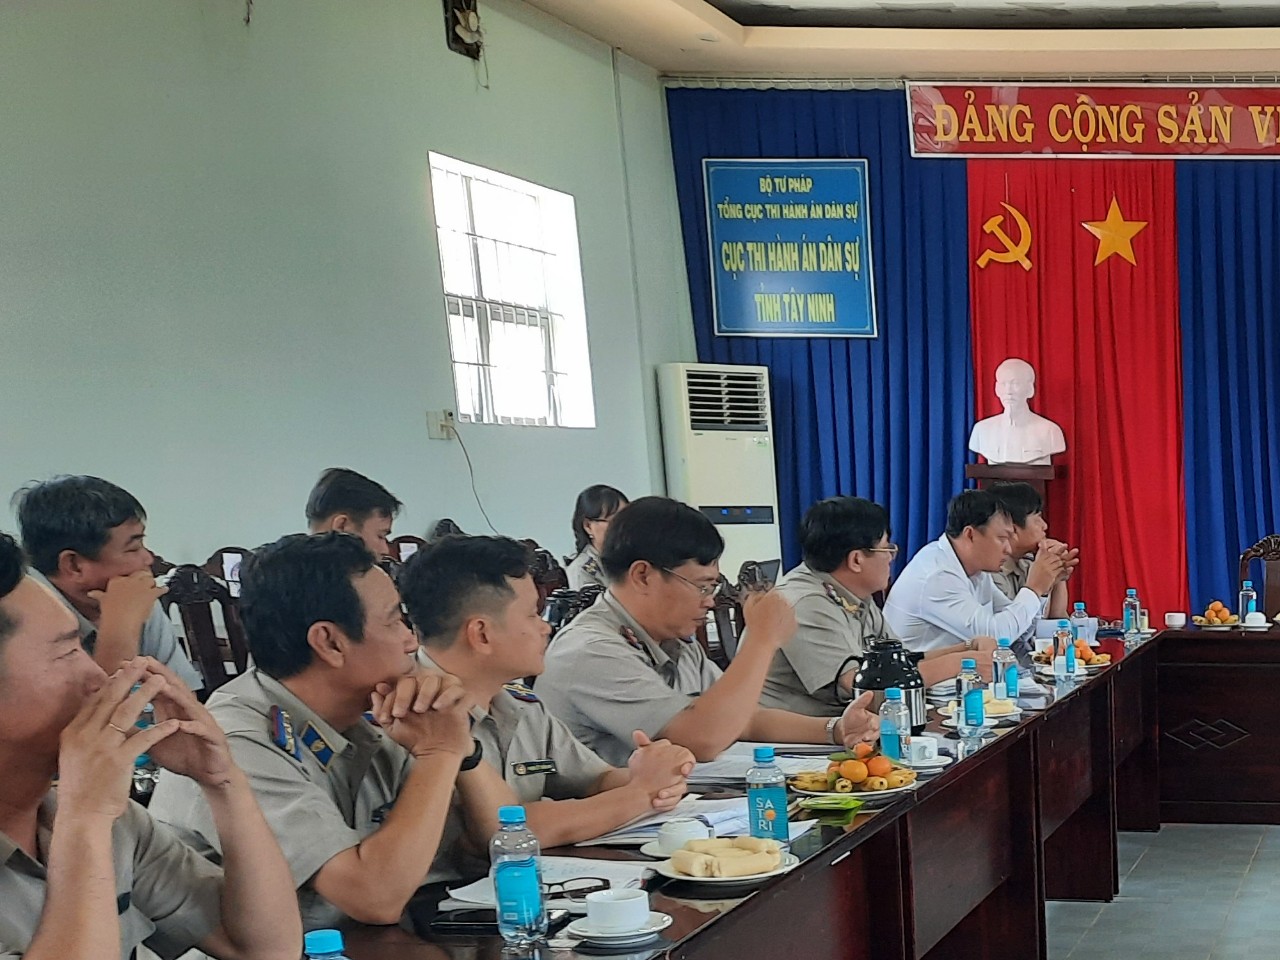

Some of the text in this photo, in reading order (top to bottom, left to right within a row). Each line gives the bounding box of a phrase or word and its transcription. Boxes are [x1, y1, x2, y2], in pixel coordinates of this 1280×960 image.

[933, 89, 1036, 144] ĐẢNG
[1048, 95, 1146, 153] CỘNG
[1156, 90, 1233, 144] SẢN
[759, 173, 813, 197] BỘ TƯ PHÁP
[717, 196, 743, 219] TỔNG
[744, 203, 763, 223] CỤC
[765, 203, 780, 219] THI
[782, 199, 808, 219] HÀNH
[845, 200, 858, 223] SỰ
[721, 233, 860, 280] CỤC THI HÀNH ÁN DÂN SỰ
[754, 282, 836, 323] TỈNH TÂY NINH
